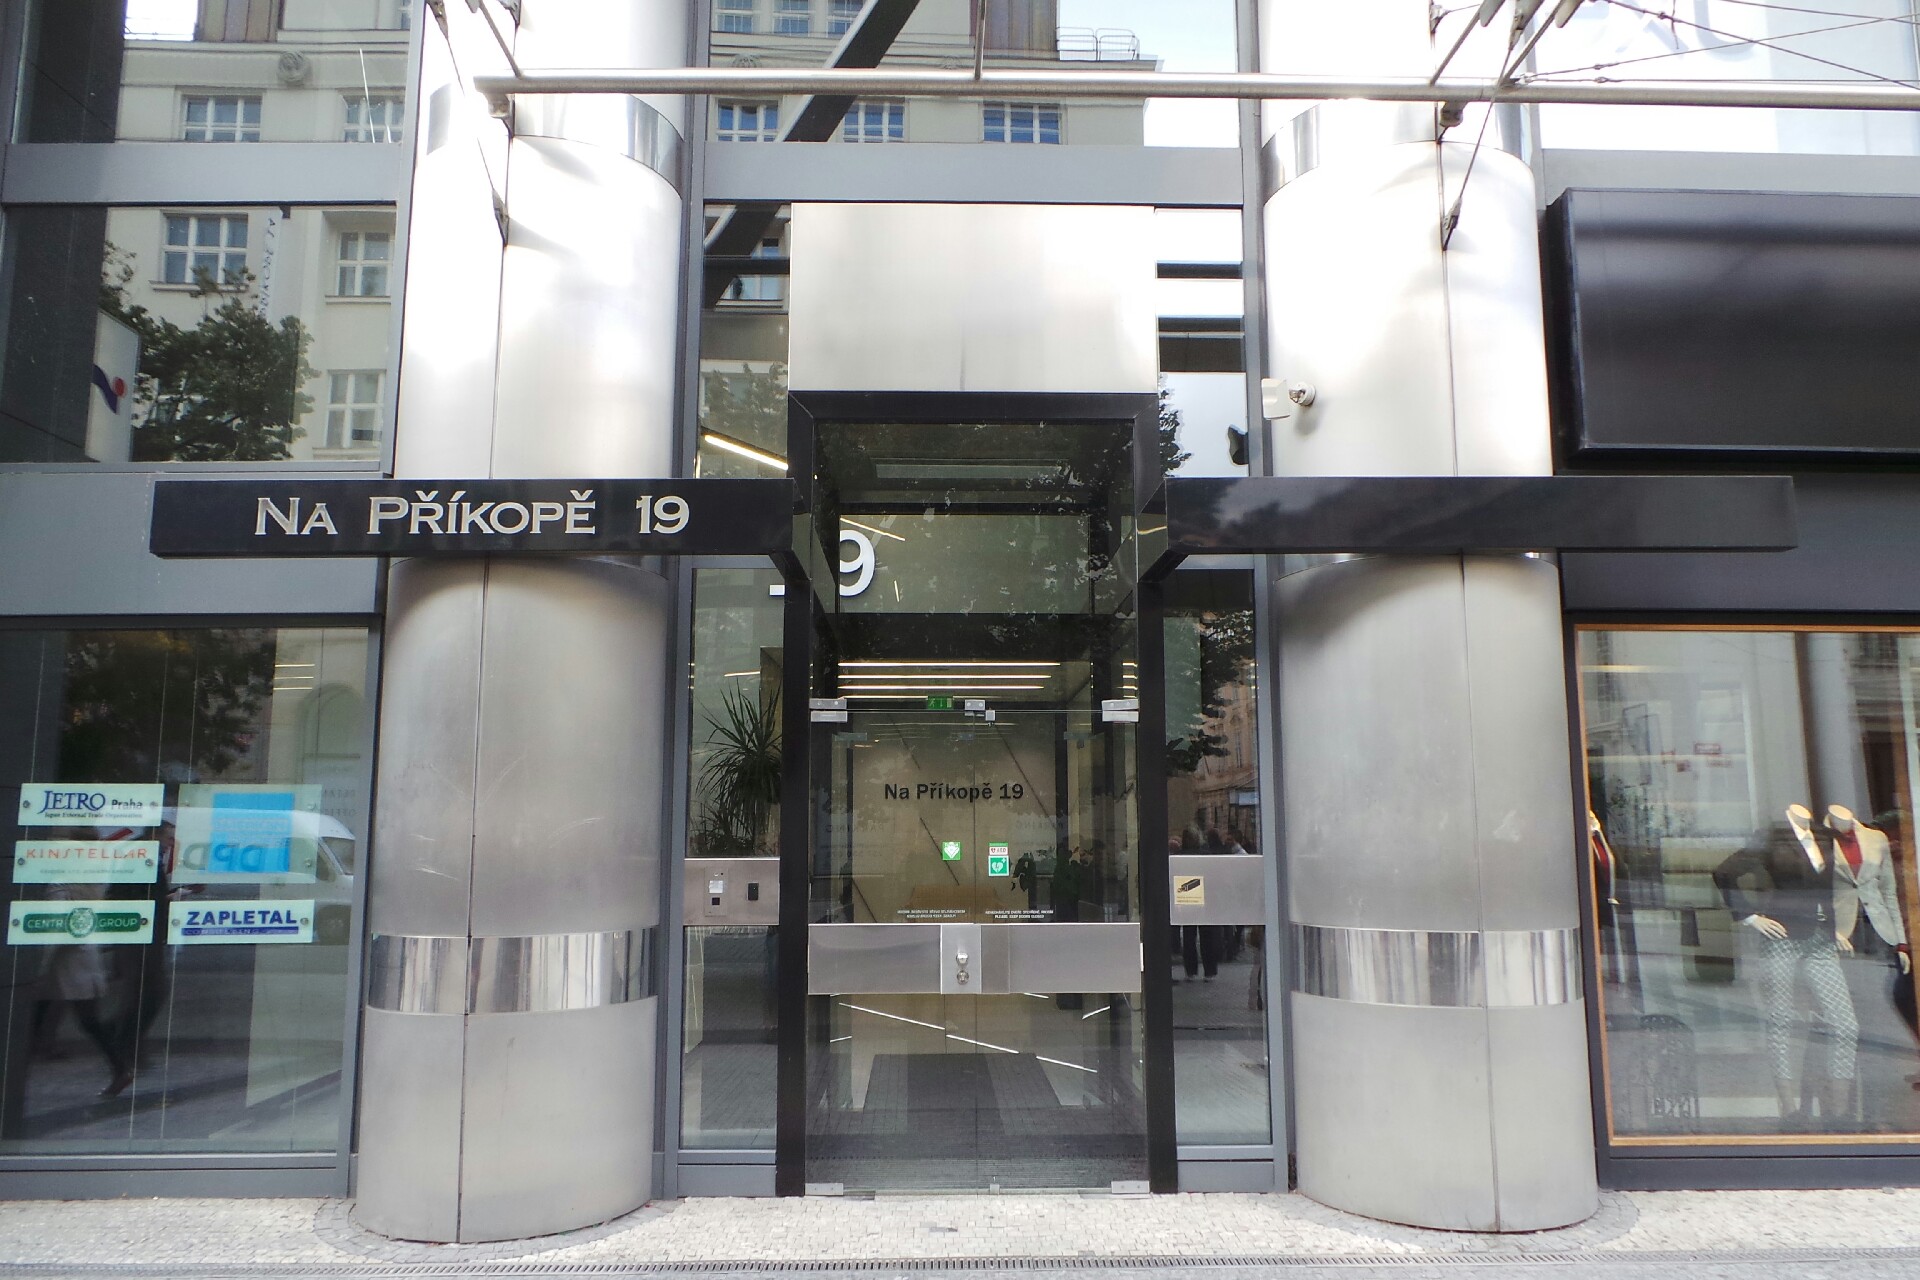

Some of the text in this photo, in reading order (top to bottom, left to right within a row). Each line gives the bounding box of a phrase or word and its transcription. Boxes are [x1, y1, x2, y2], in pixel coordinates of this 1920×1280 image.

[366, 489, 597, 535] PŘÍKOPĚ
[636, 495, 690, 535] 19
[884, 782, 1024, 803] Na Příkopě 19
[37, 790, 143, 814] JETRO Praha
[26, 848, 148, 859] KINSTELLAR
[99, 917, 138, 928] GROUP
[186, 910, 298, 926] ZAPLETAL
